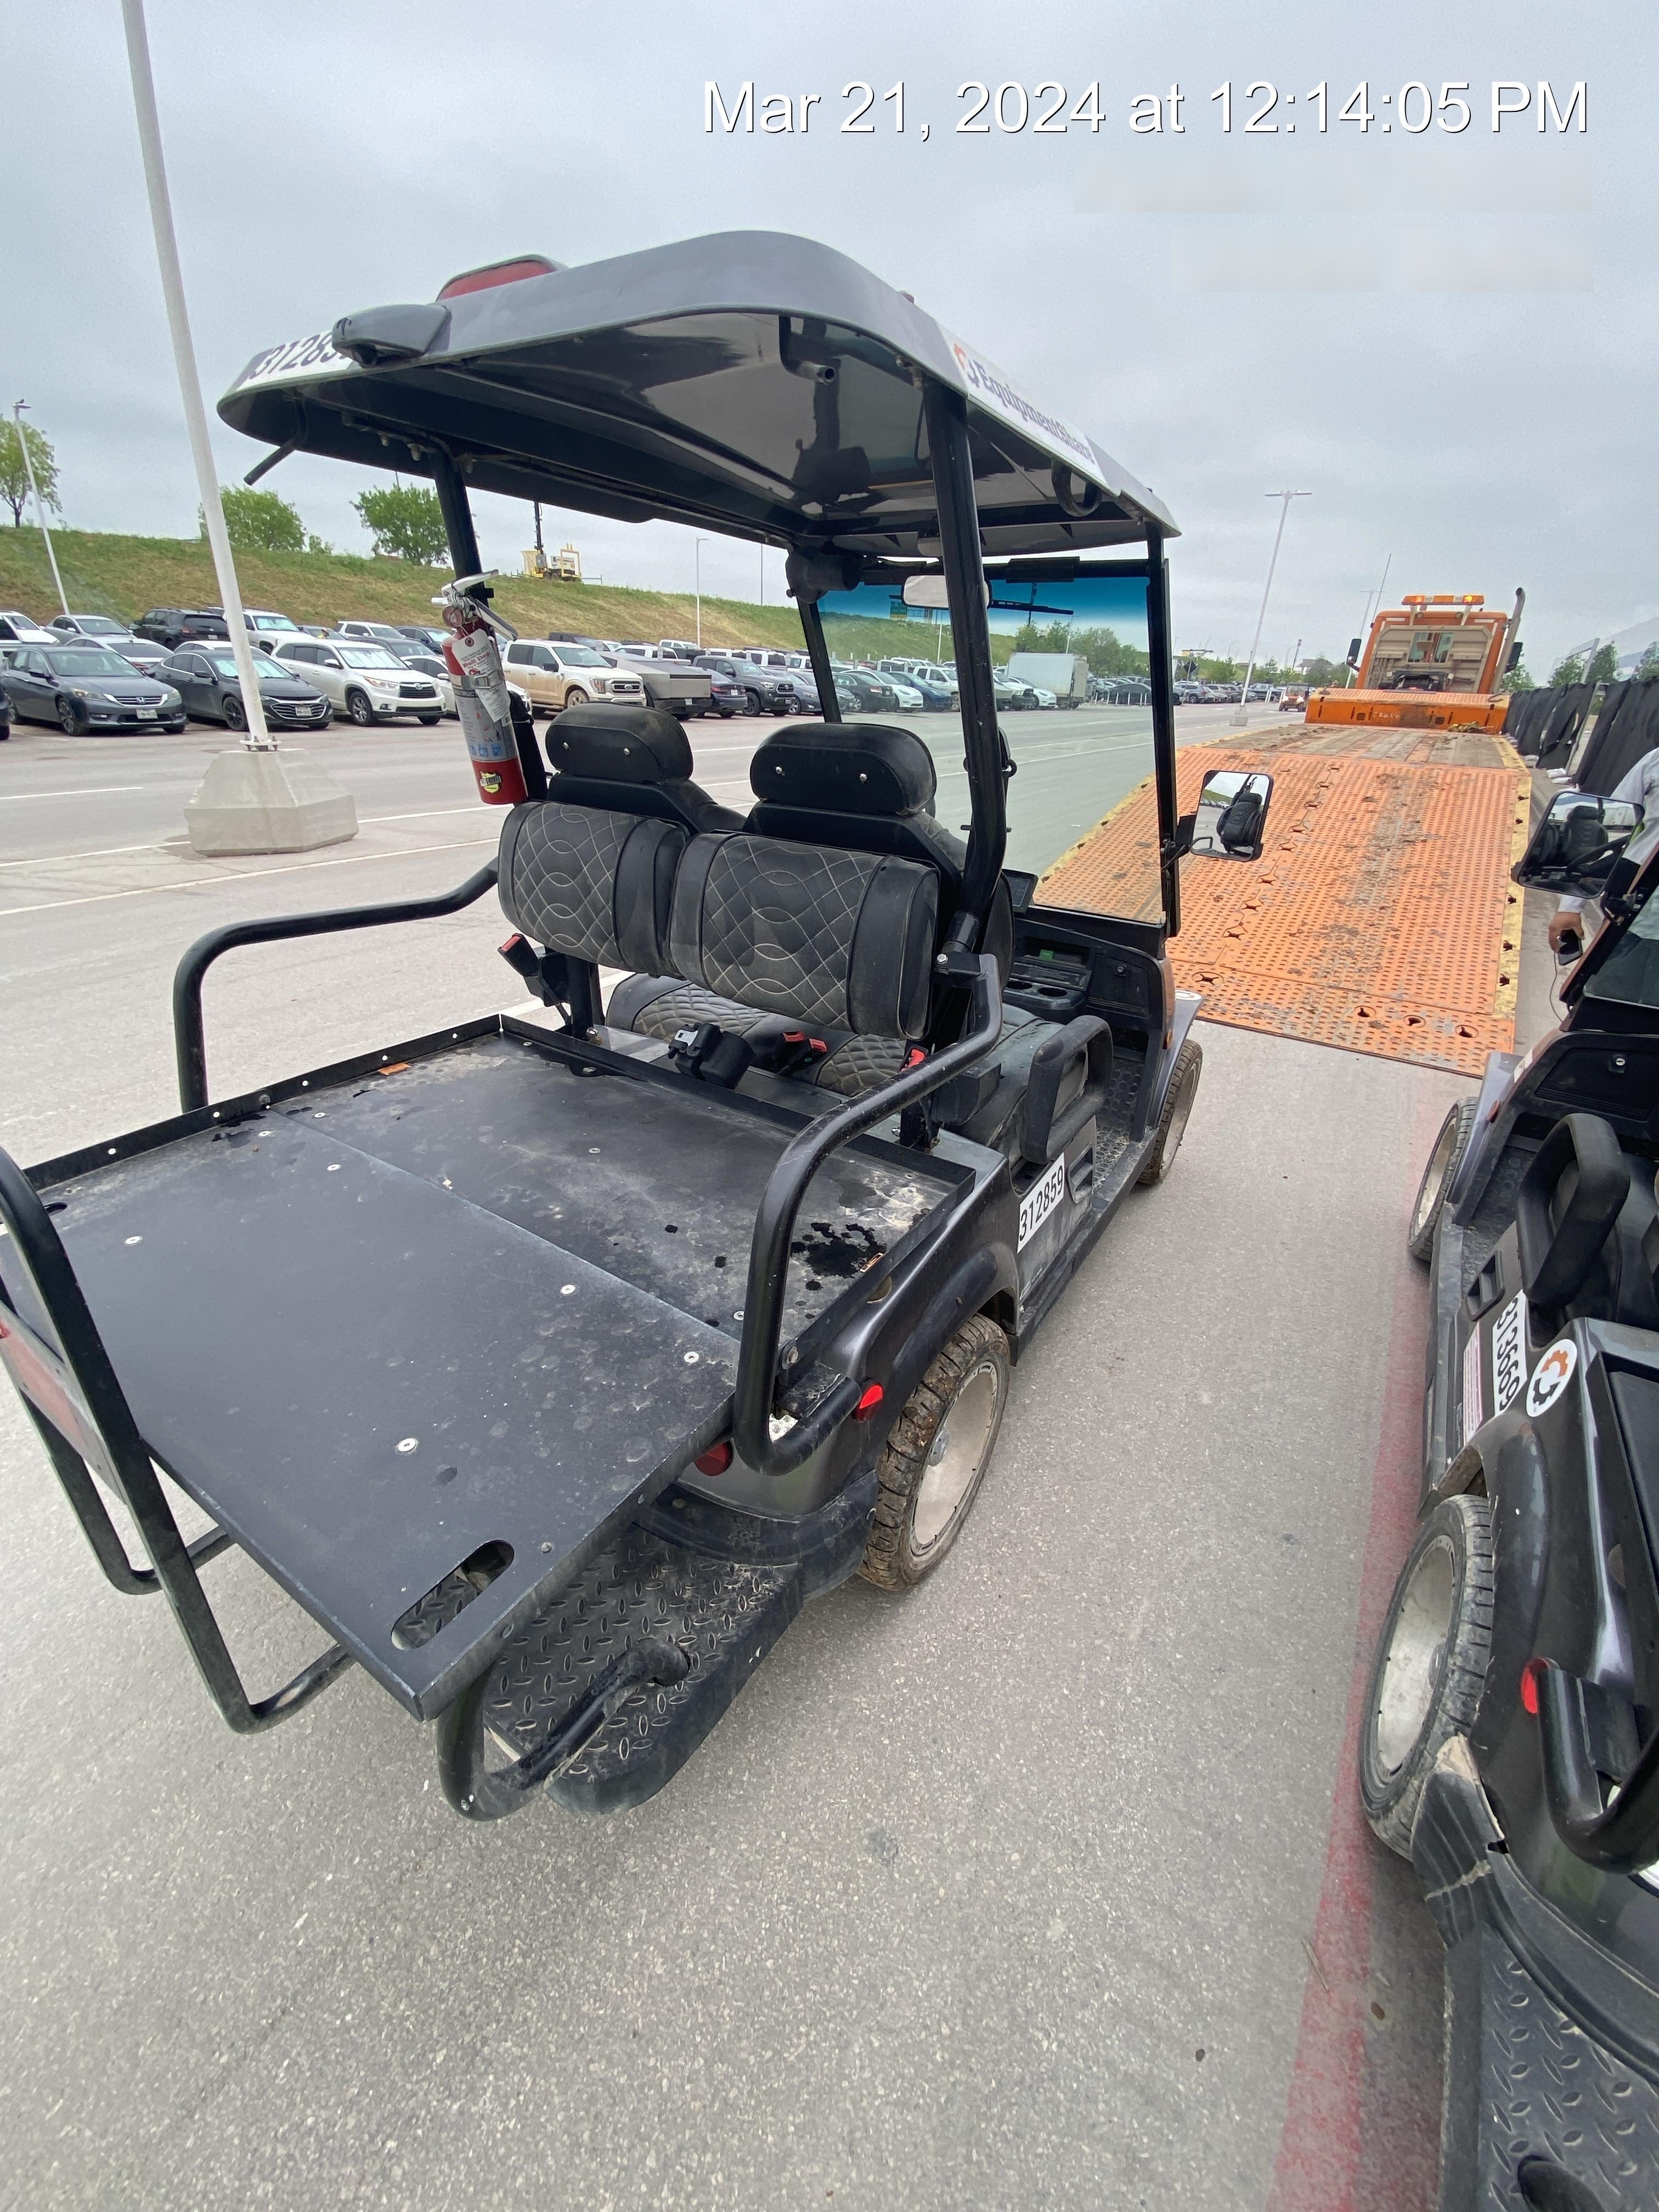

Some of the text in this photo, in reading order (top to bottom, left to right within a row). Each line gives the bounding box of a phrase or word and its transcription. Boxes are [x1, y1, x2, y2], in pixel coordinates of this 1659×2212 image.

[974, 360, 1096, 465] EquipmentShare
[462, 658, 477, 668] Bull
[1019, 1165, 1063, 1242] 312859
[1497, 1297, 1520, 1412] 313669
